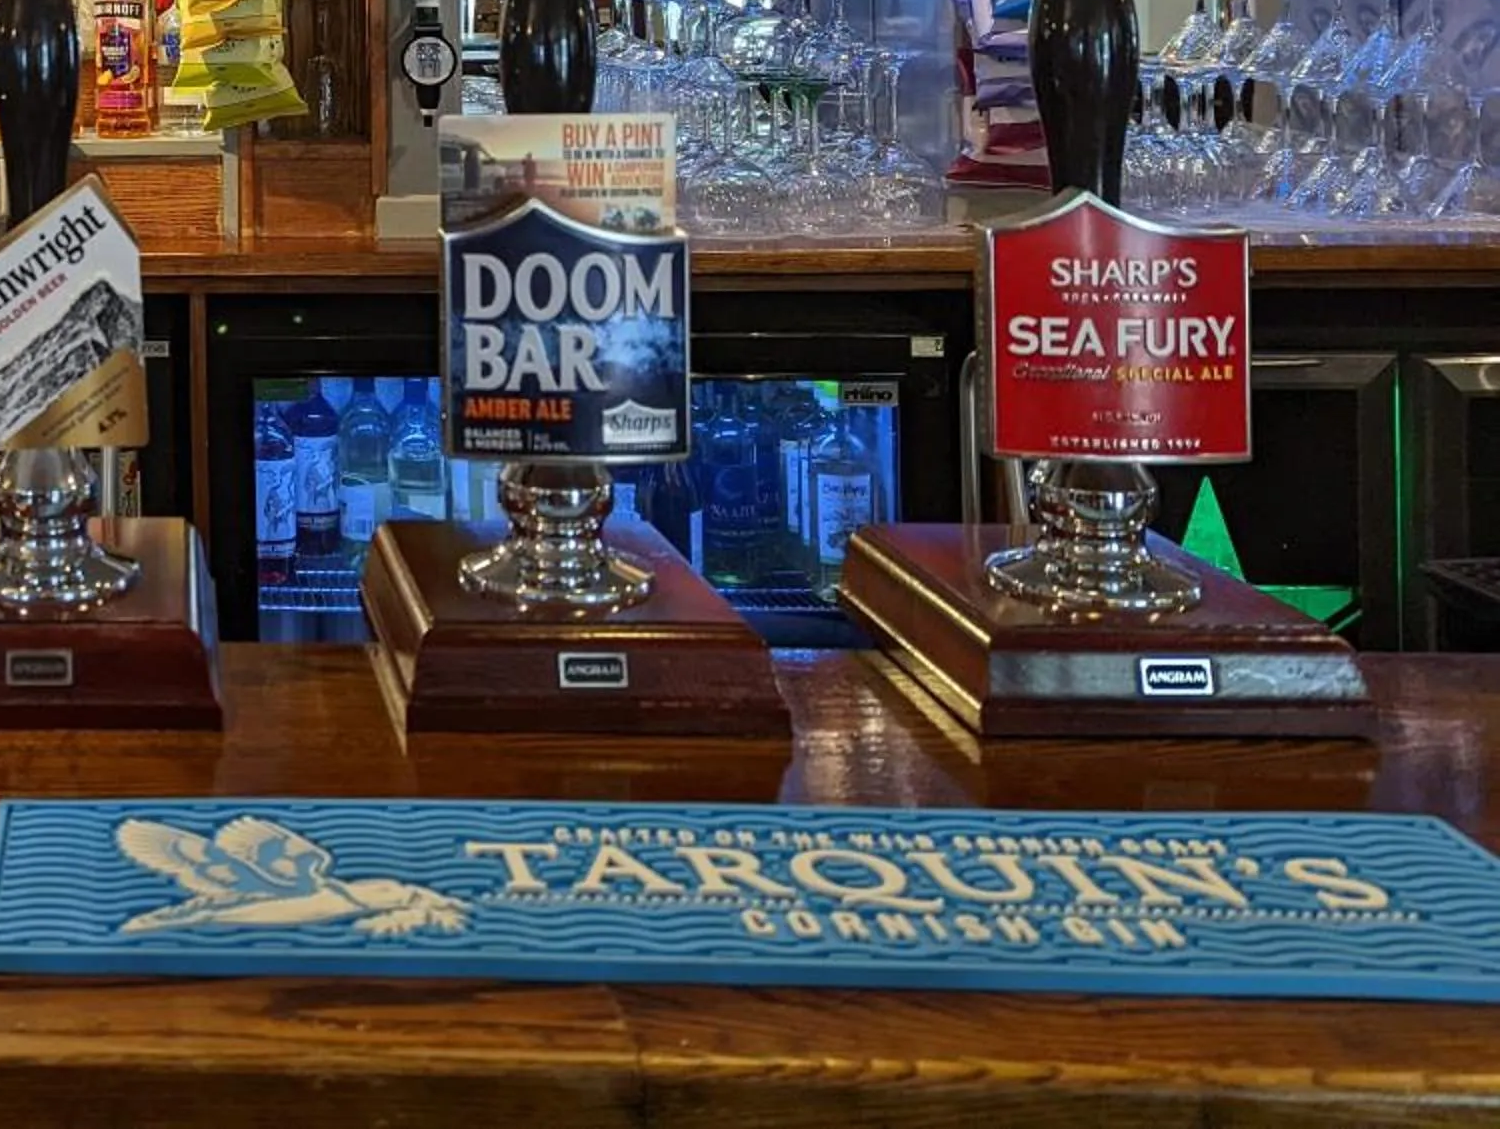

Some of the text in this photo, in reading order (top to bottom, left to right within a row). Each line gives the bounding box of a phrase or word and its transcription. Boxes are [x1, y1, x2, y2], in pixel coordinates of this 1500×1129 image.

[562, 122, 664, 148] BUY A PINT
[566, 161, 605, 187] WIN
[1050, 256, 1198, 288] SHARP'S
[461, 252, 675, 322] DOOM
[1008, 315, 1236, 359] SEA FURY
[464, 322, 612, 393] BAR
[1114, 364, 1196, 382] SPECIAL
[1199, 364, 1234, 382] ALE
[463, 397, 573, 420] AMBER ALE
[1148, 670, 1207, 684] ANGRAM
[553, 826, 697, 847] CRAFTED
[713, 828, 757, 848] ON
[771, 830, 836, 850] THE
[464, 841, 1391, 912] TARQUIN'S
[740, 907, 1187, 948] CORNISH GIN
